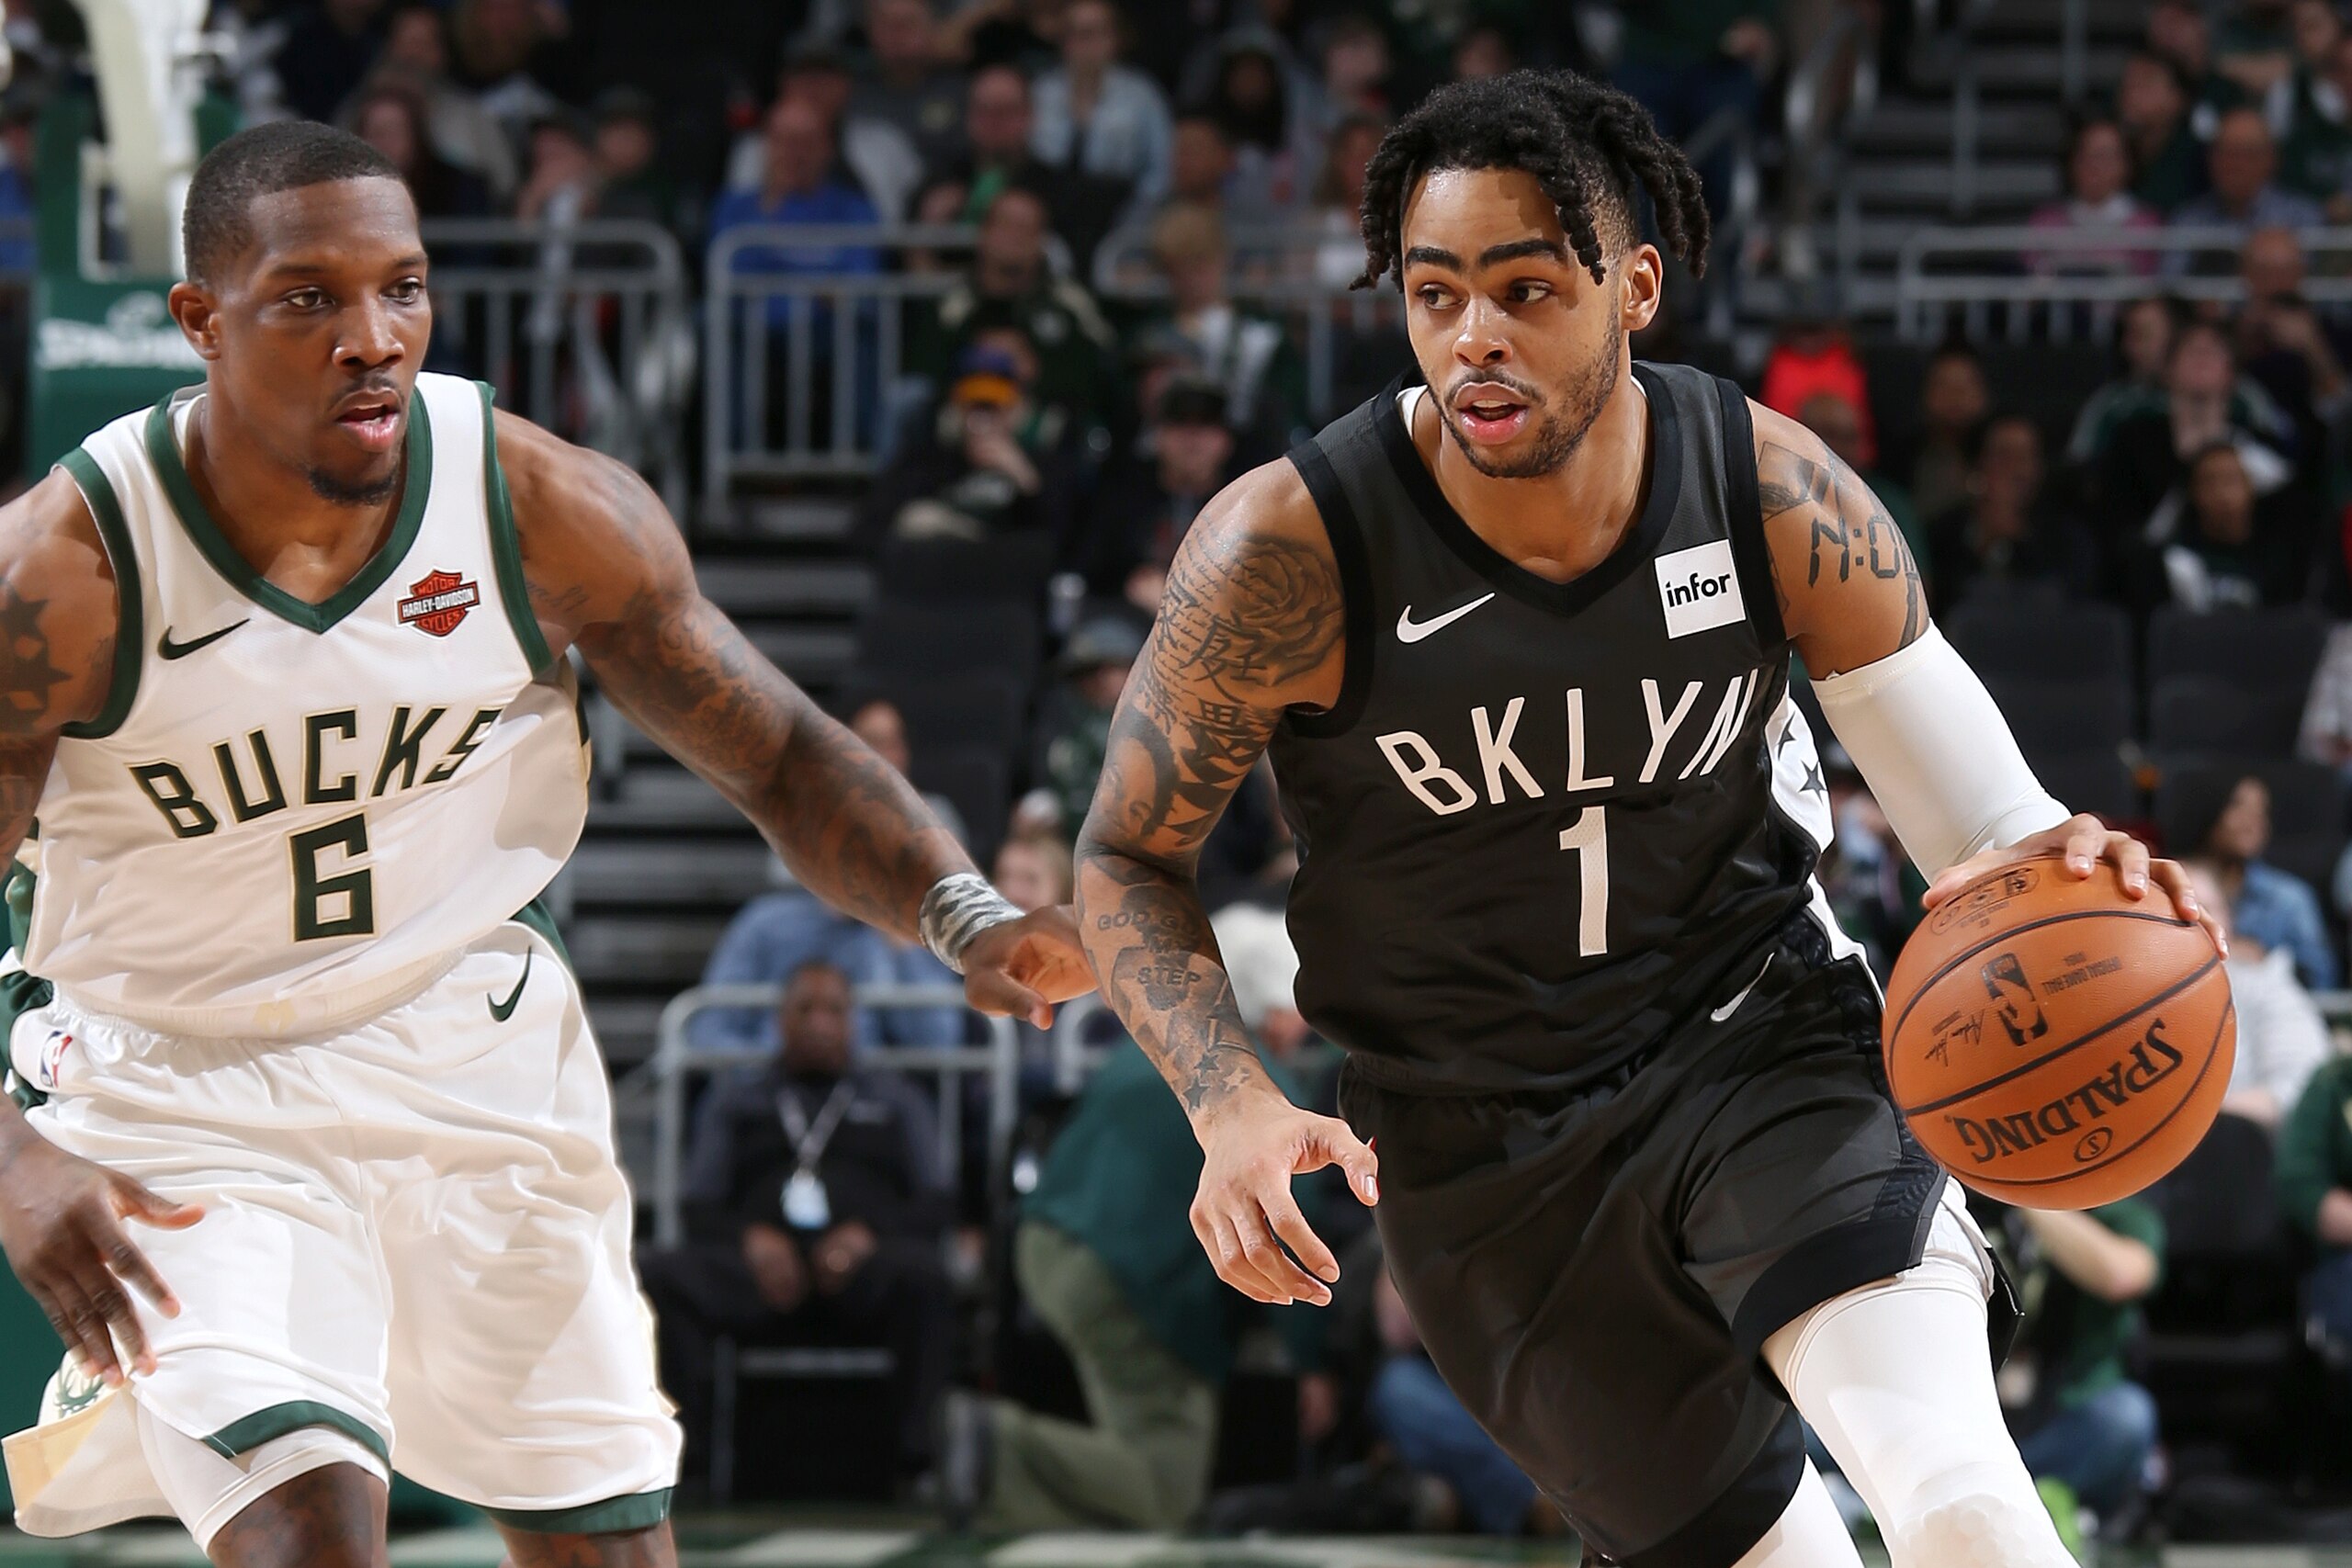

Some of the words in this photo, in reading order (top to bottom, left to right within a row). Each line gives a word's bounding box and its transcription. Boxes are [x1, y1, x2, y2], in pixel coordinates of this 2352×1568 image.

[401, 587, 475, 618] HARLEY-DAVIDSON
[418, 577, 457, 595] MOTOR
[1665, 571, 1731, 608] infor
[124, 704, 506, 840] BUCKS
[1374, 668, 1758, 817] BKLYN
[288, 809, 379, 943] 6
[1558, 805, 1609, 957] 1
[1137, 965, 1202, 987] STEP
[1953, 1018, 2183, 1164] SPALDING
